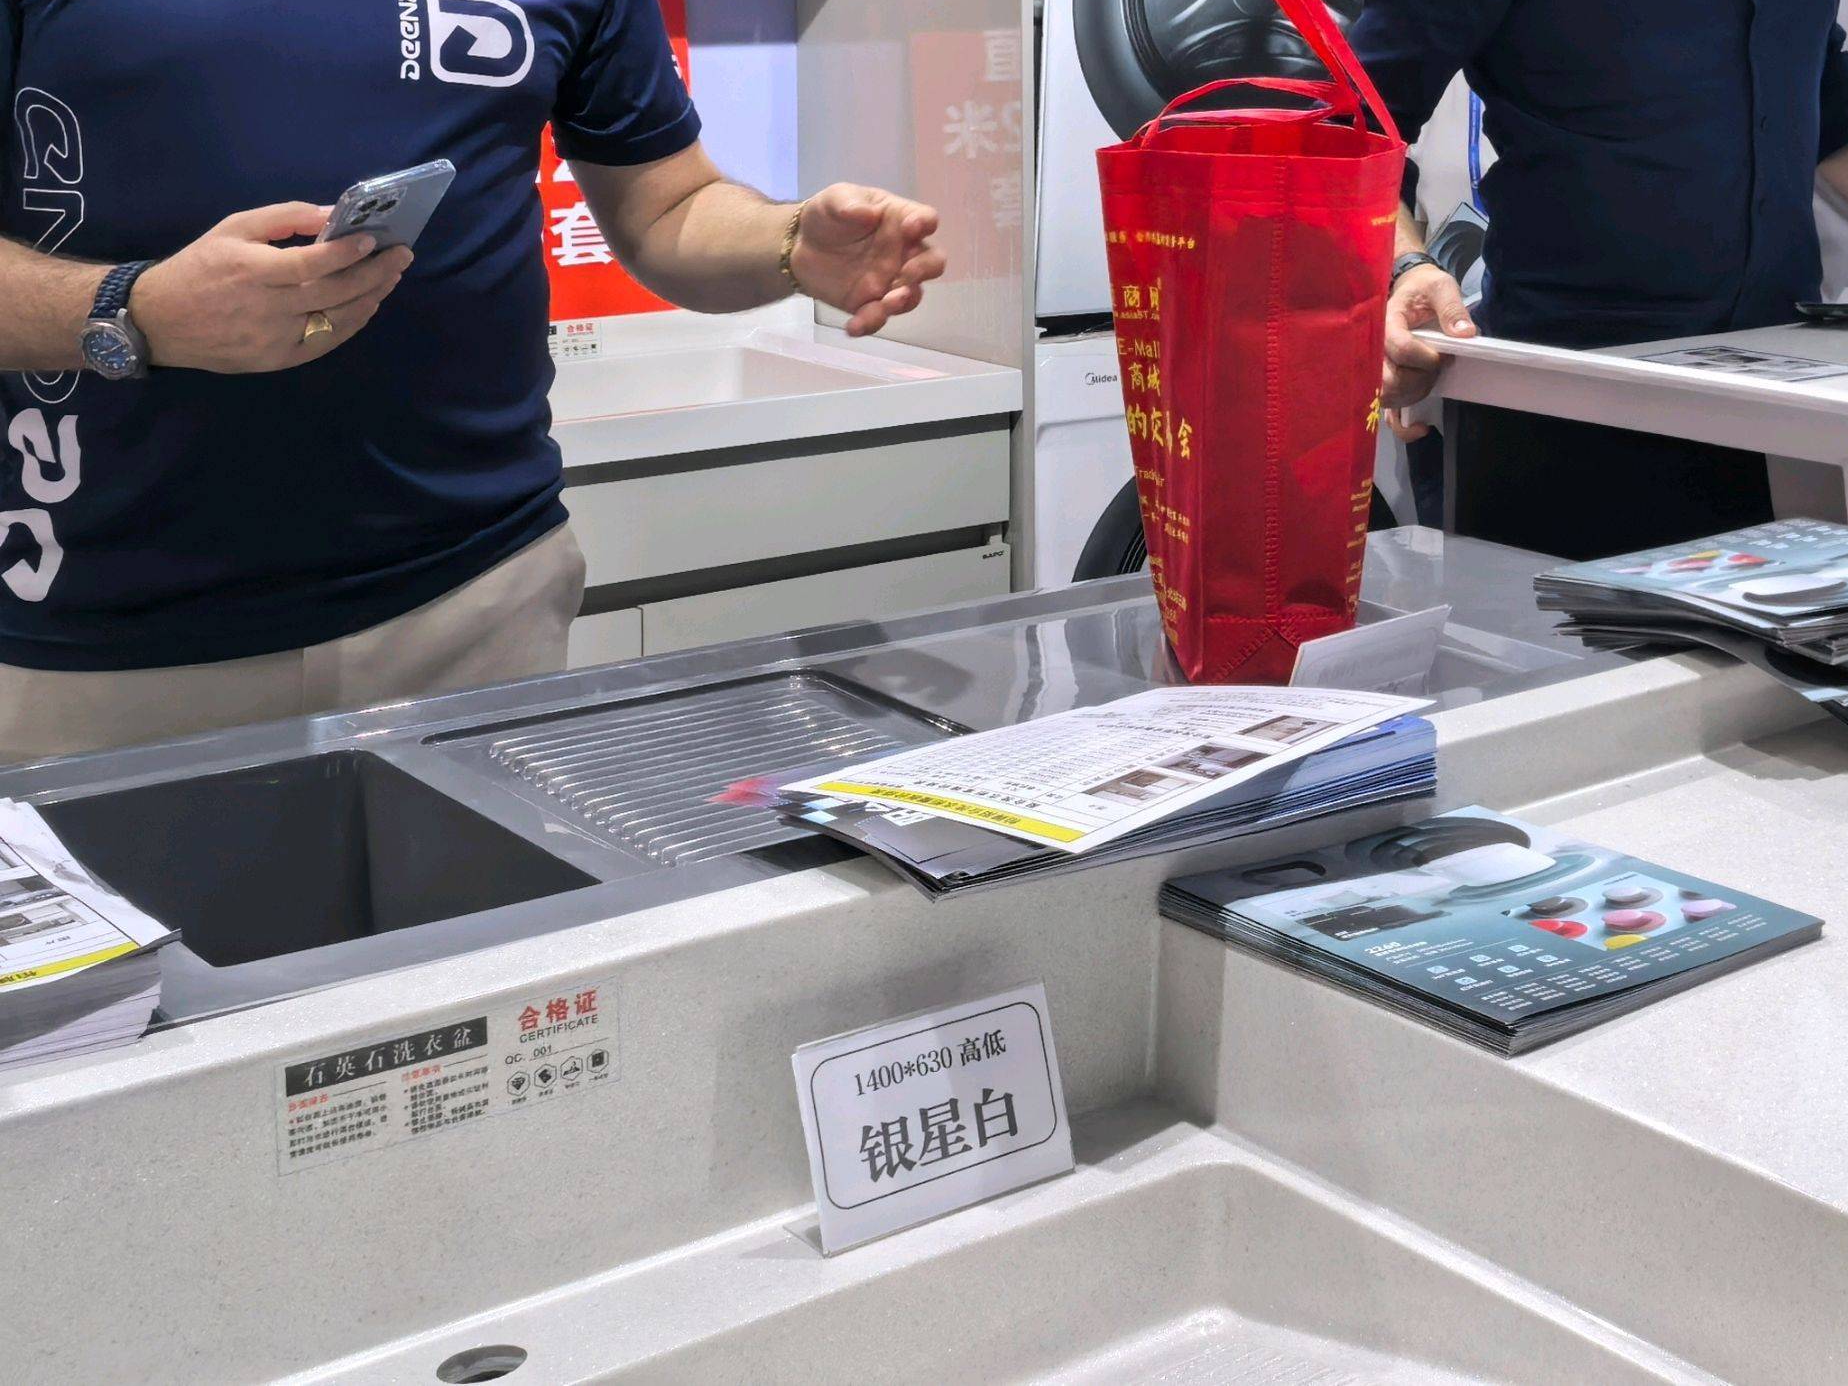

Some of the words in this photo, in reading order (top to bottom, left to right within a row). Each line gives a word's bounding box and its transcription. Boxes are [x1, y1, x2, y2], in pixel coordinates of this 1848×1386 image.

[1117, 338, 1161, 358] E-Mall
[1126, 402, 1193, 461] 的交会
[518, 988, 597, 1032] 合格证
[519, 1014, 599, 1044] CERTIFICATE
[303, 1027, 473, 1089] 石英石洗衣盆
[533, 1045, 552, 1058] 001
[957, 1029, 1006, 1067] 高低
[859, 1088, 1018, 1183] 银星白
